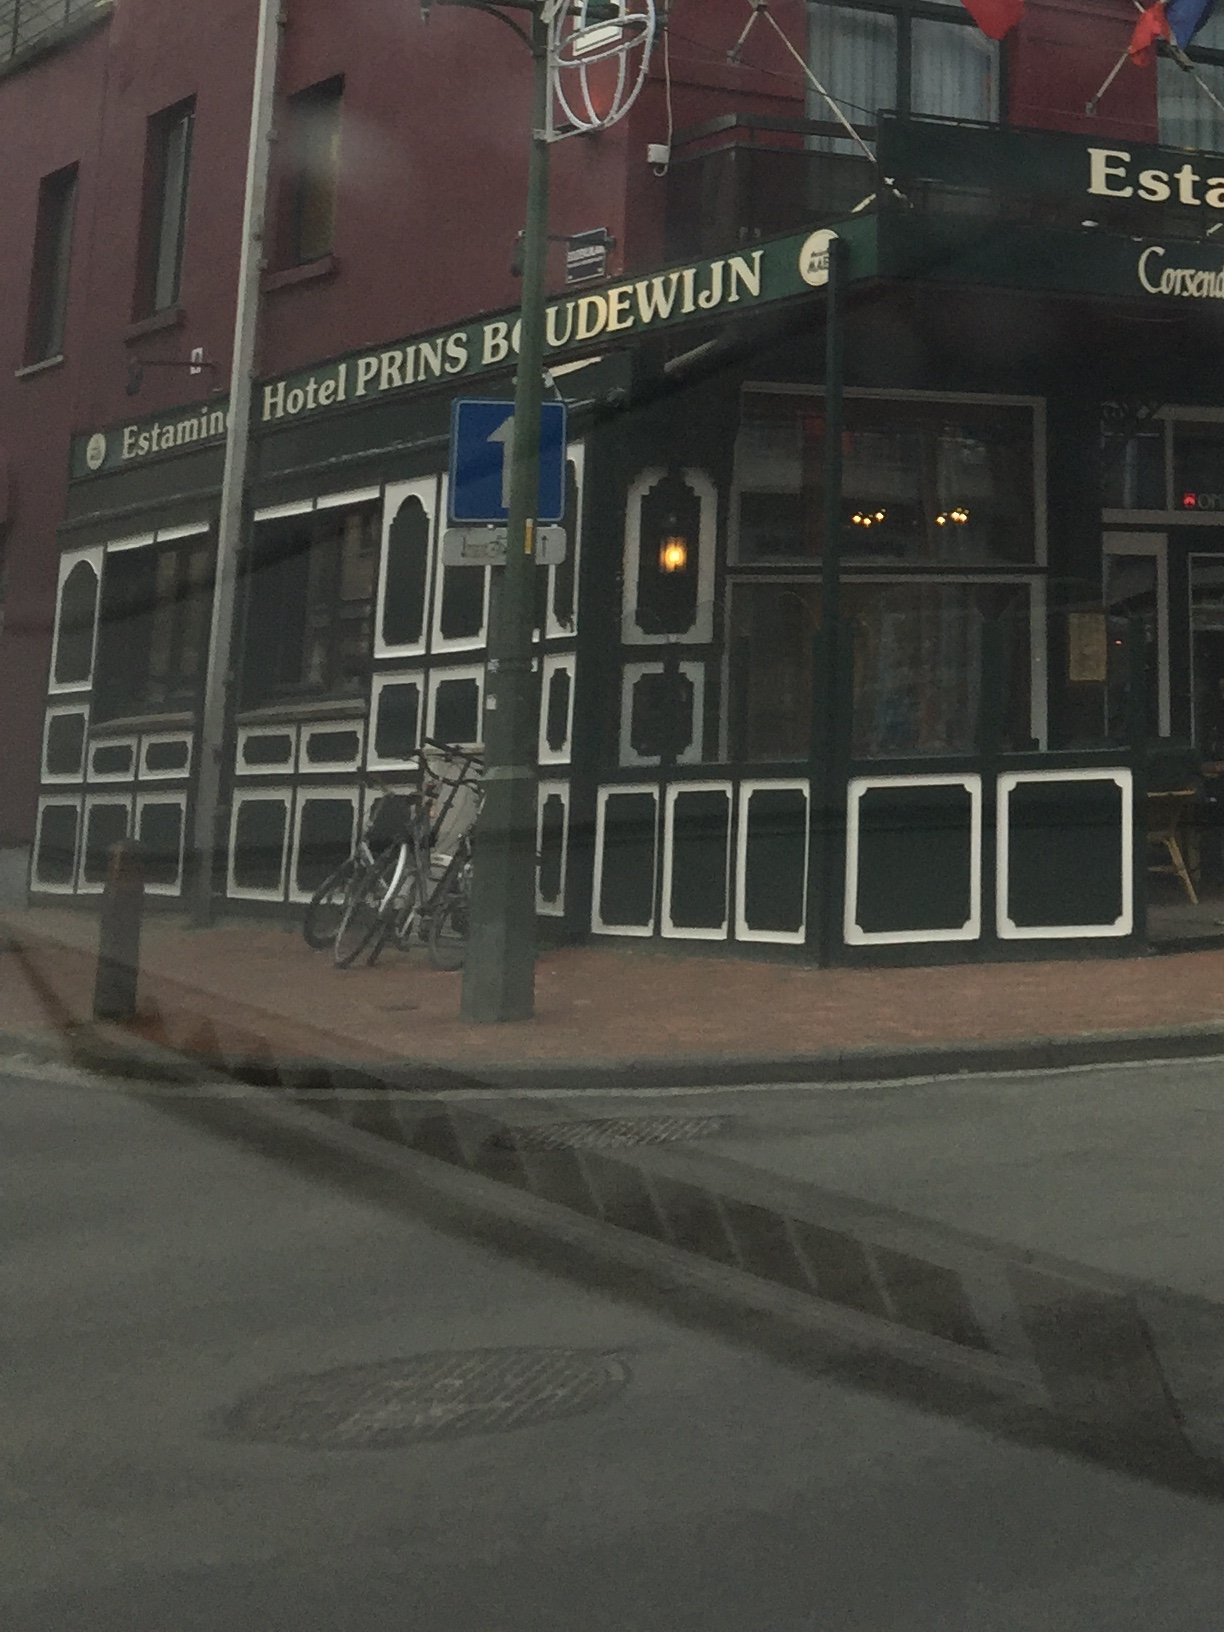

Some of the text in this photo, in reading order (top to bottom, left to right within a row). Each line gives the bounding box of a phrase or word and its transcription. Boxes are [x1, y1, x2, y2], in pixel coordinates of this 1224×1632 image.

[120, 406, 238, 461] Estamin
[262, 362, 347, 422] Hotel
[354, 332, 468, 397] PRINS
